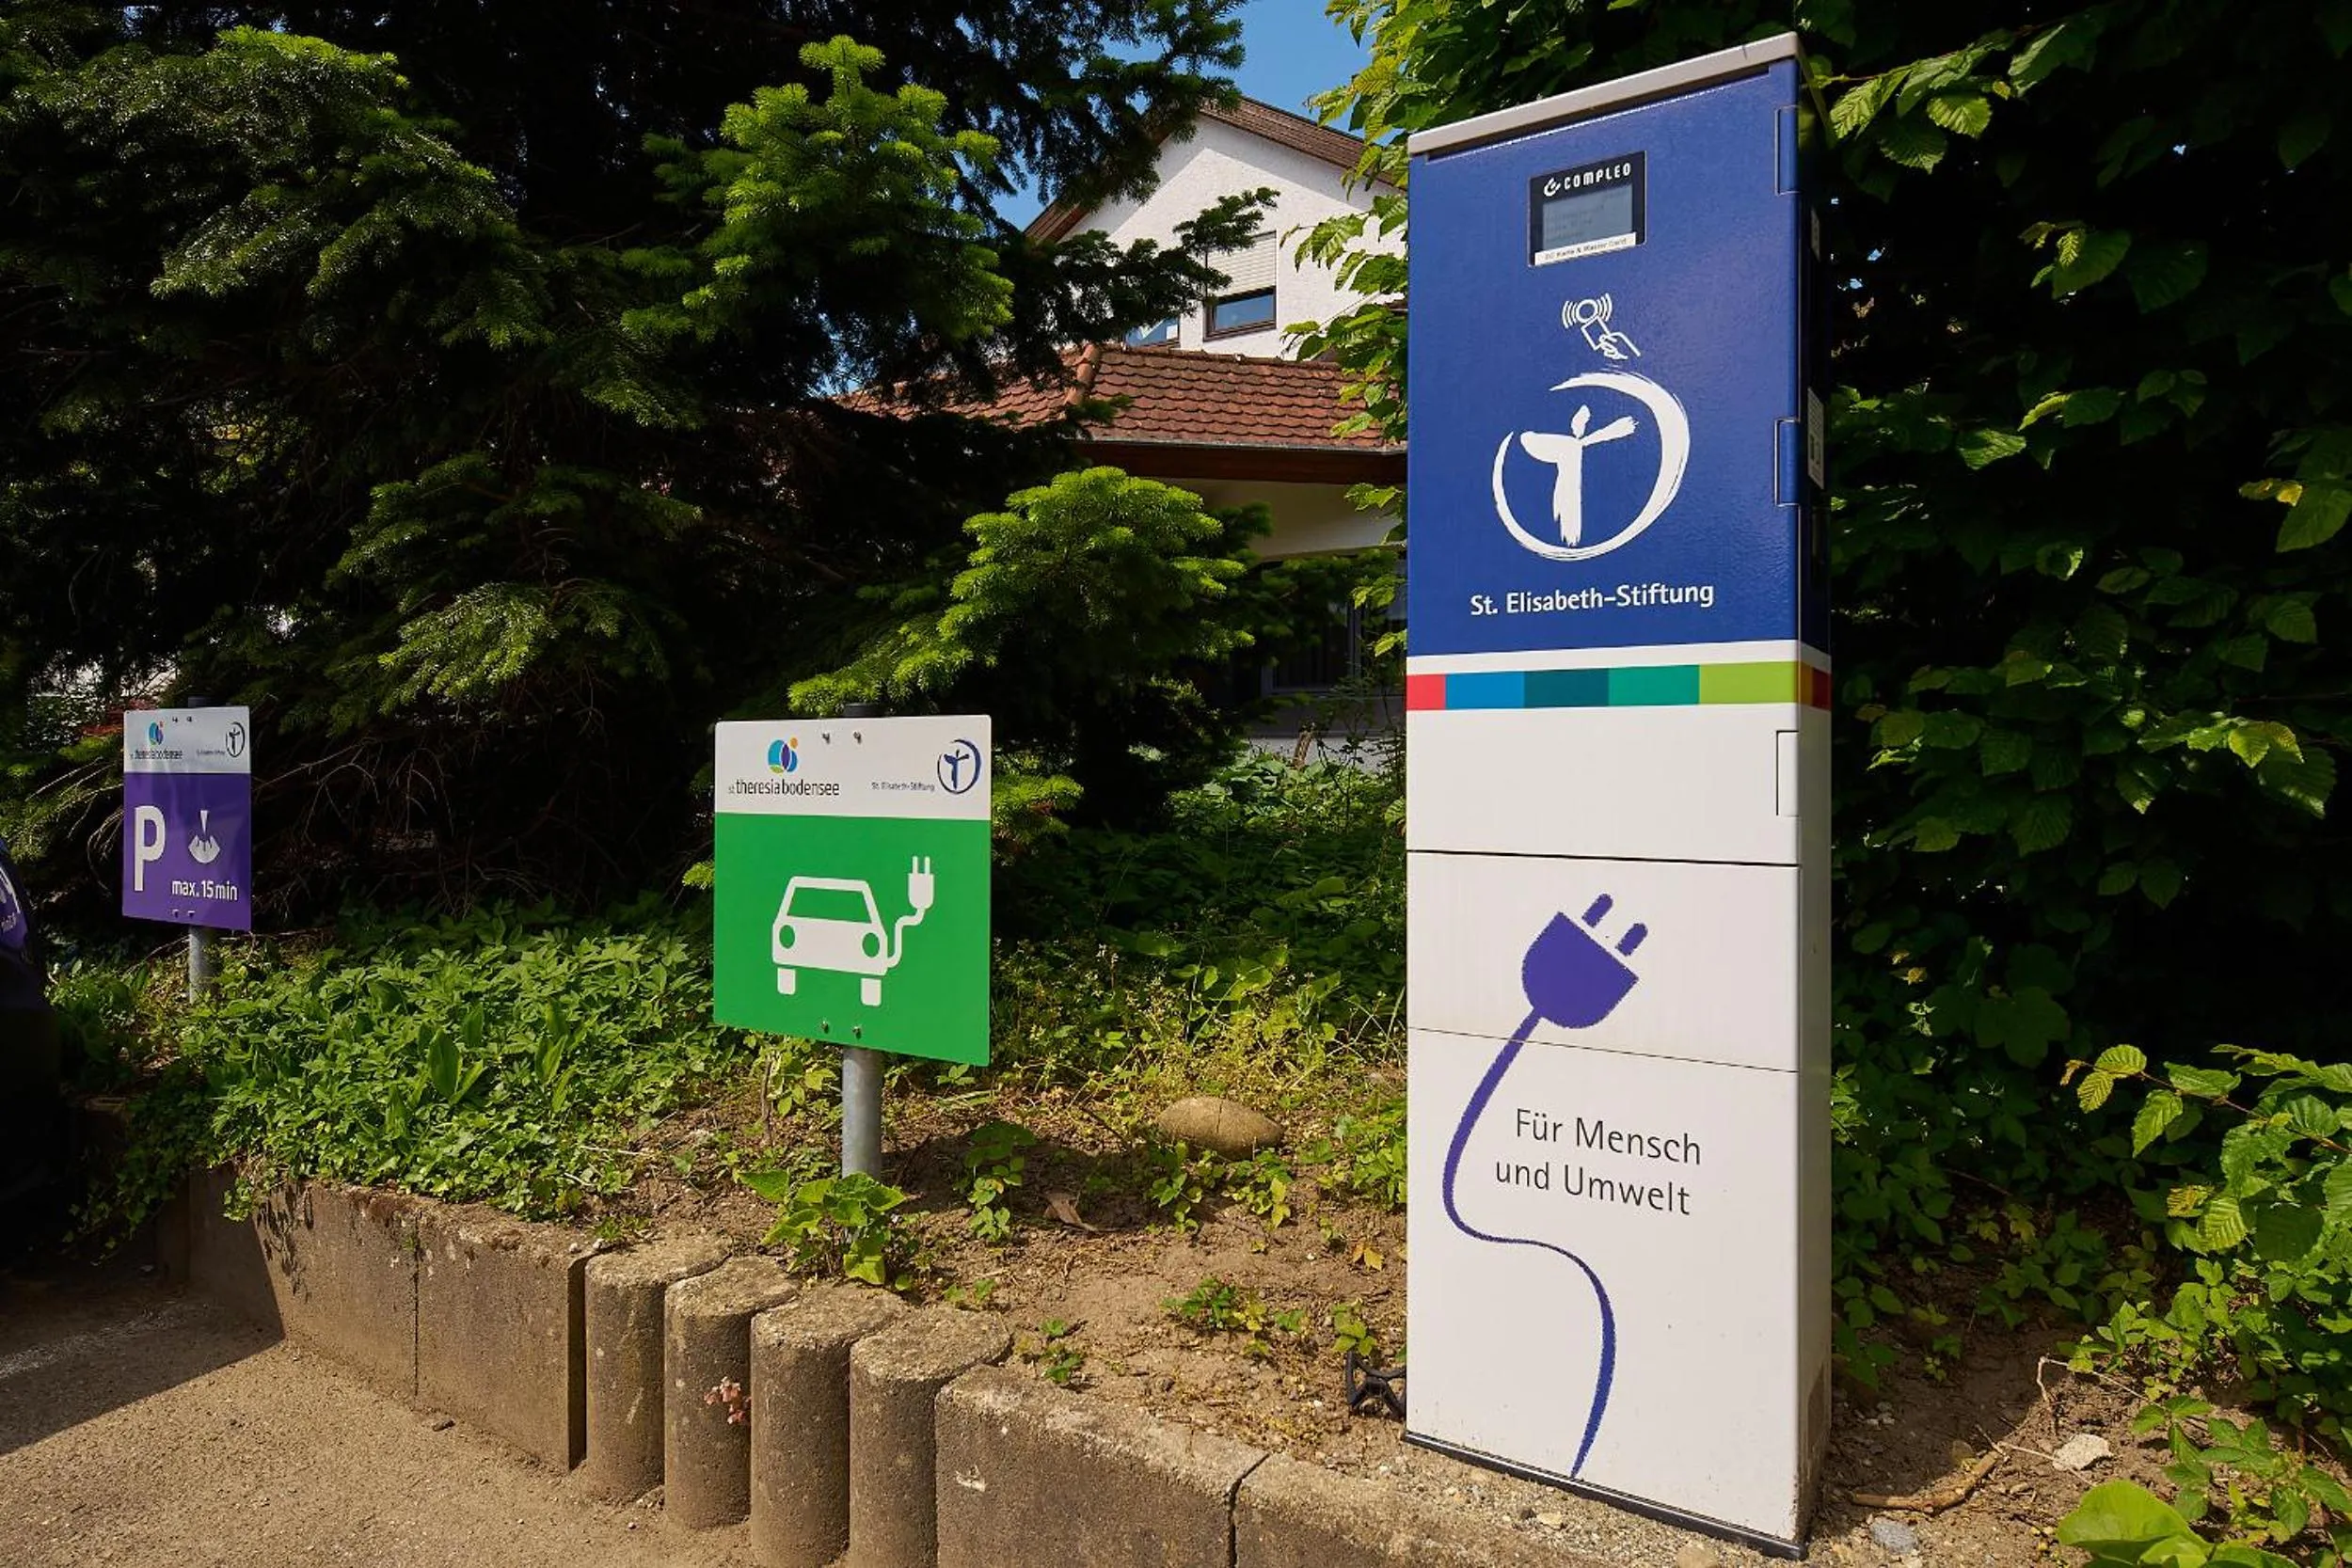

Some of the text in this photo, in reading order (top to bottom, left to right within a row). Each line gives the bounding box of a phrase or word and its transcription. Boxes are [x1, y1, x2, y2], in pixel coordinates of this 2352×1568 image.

[1564, 163, 1631, 190] COMPLEO
[1470, 582, 1714, 615] St. Elisabeth-Stiftung
[134, 805, 167, 892] P
[171, 879, 199, 897] max.
[1516, 1107, 1701, 1165] Für Mensch
[1496, 1161, 1691, 1215] und Umwelt
